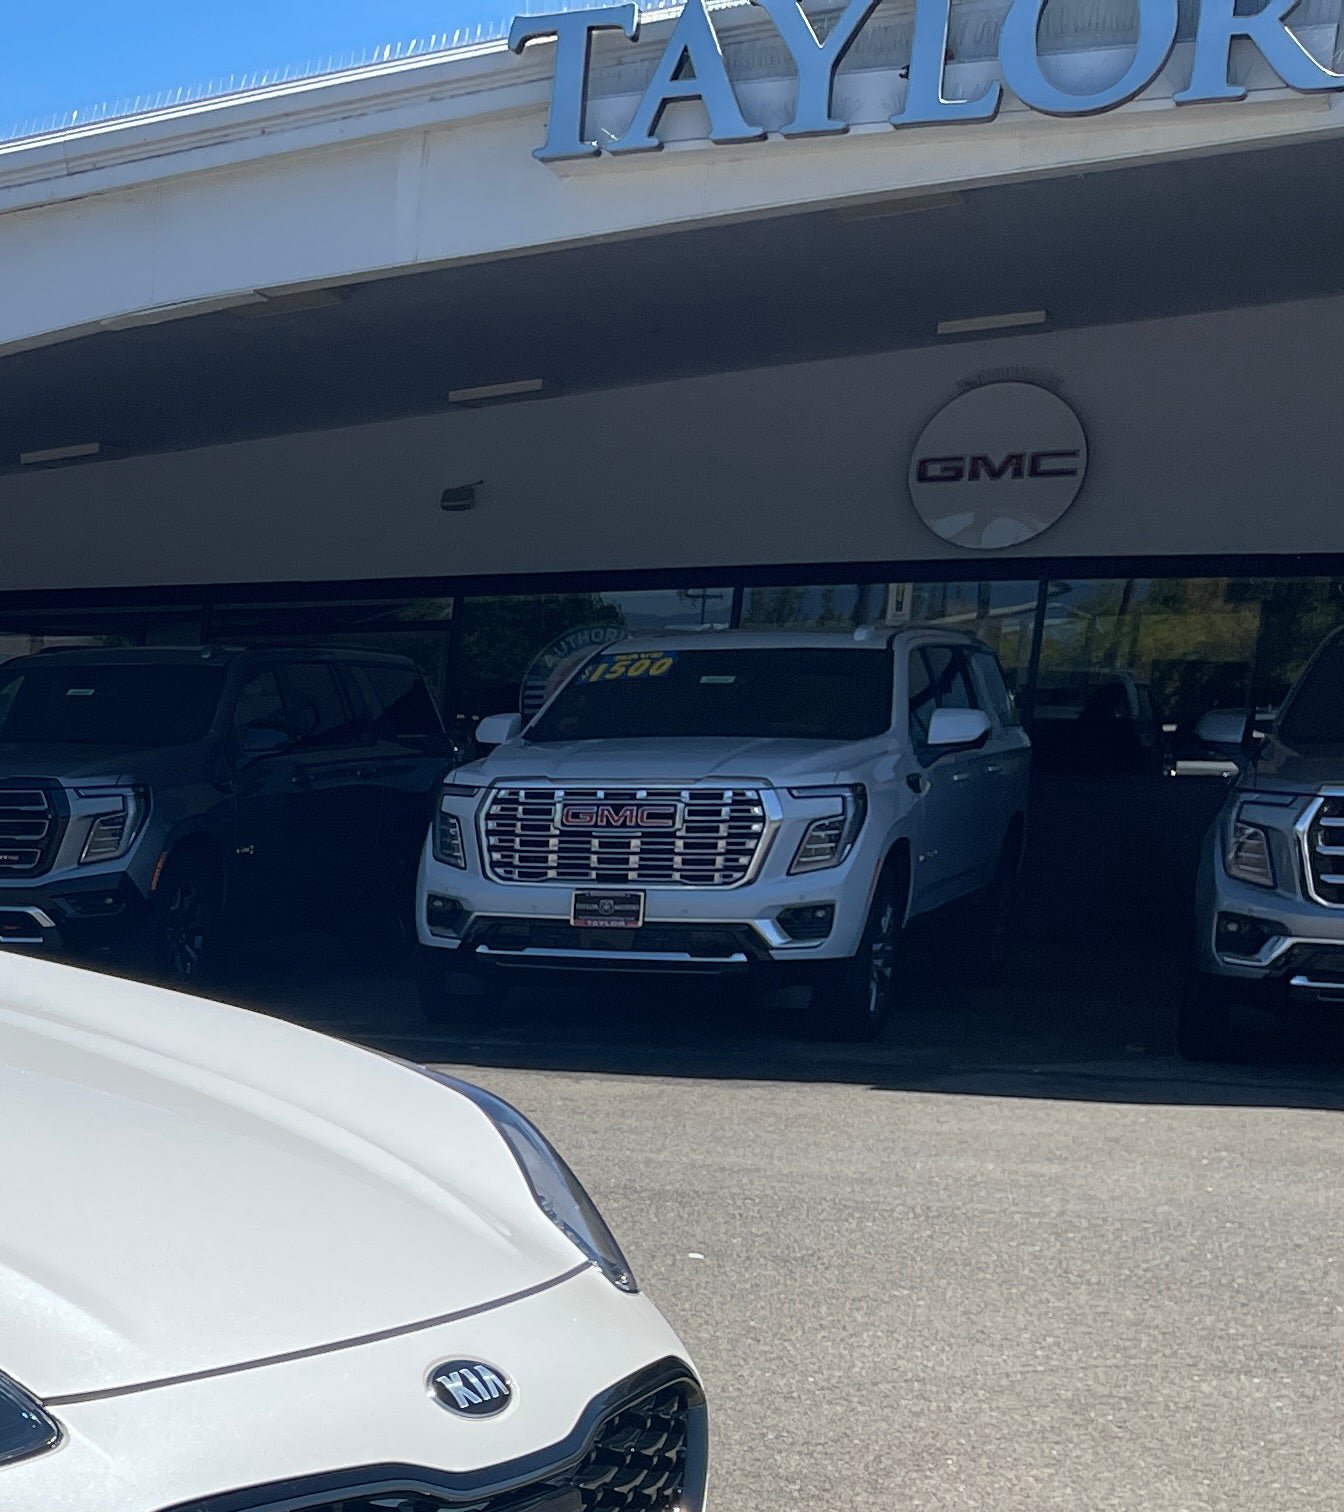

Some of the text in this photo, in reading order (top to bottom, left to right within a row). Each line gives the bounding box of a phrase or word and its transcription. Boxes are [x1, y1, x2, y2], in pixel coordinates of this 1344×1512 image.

[508, 0, 1344, 161] TAYLOR
[917, 449, 1080, 483] GMC
[562, 805, 675, 826] GMC
[436, 1365, 510, 1408] KIA
